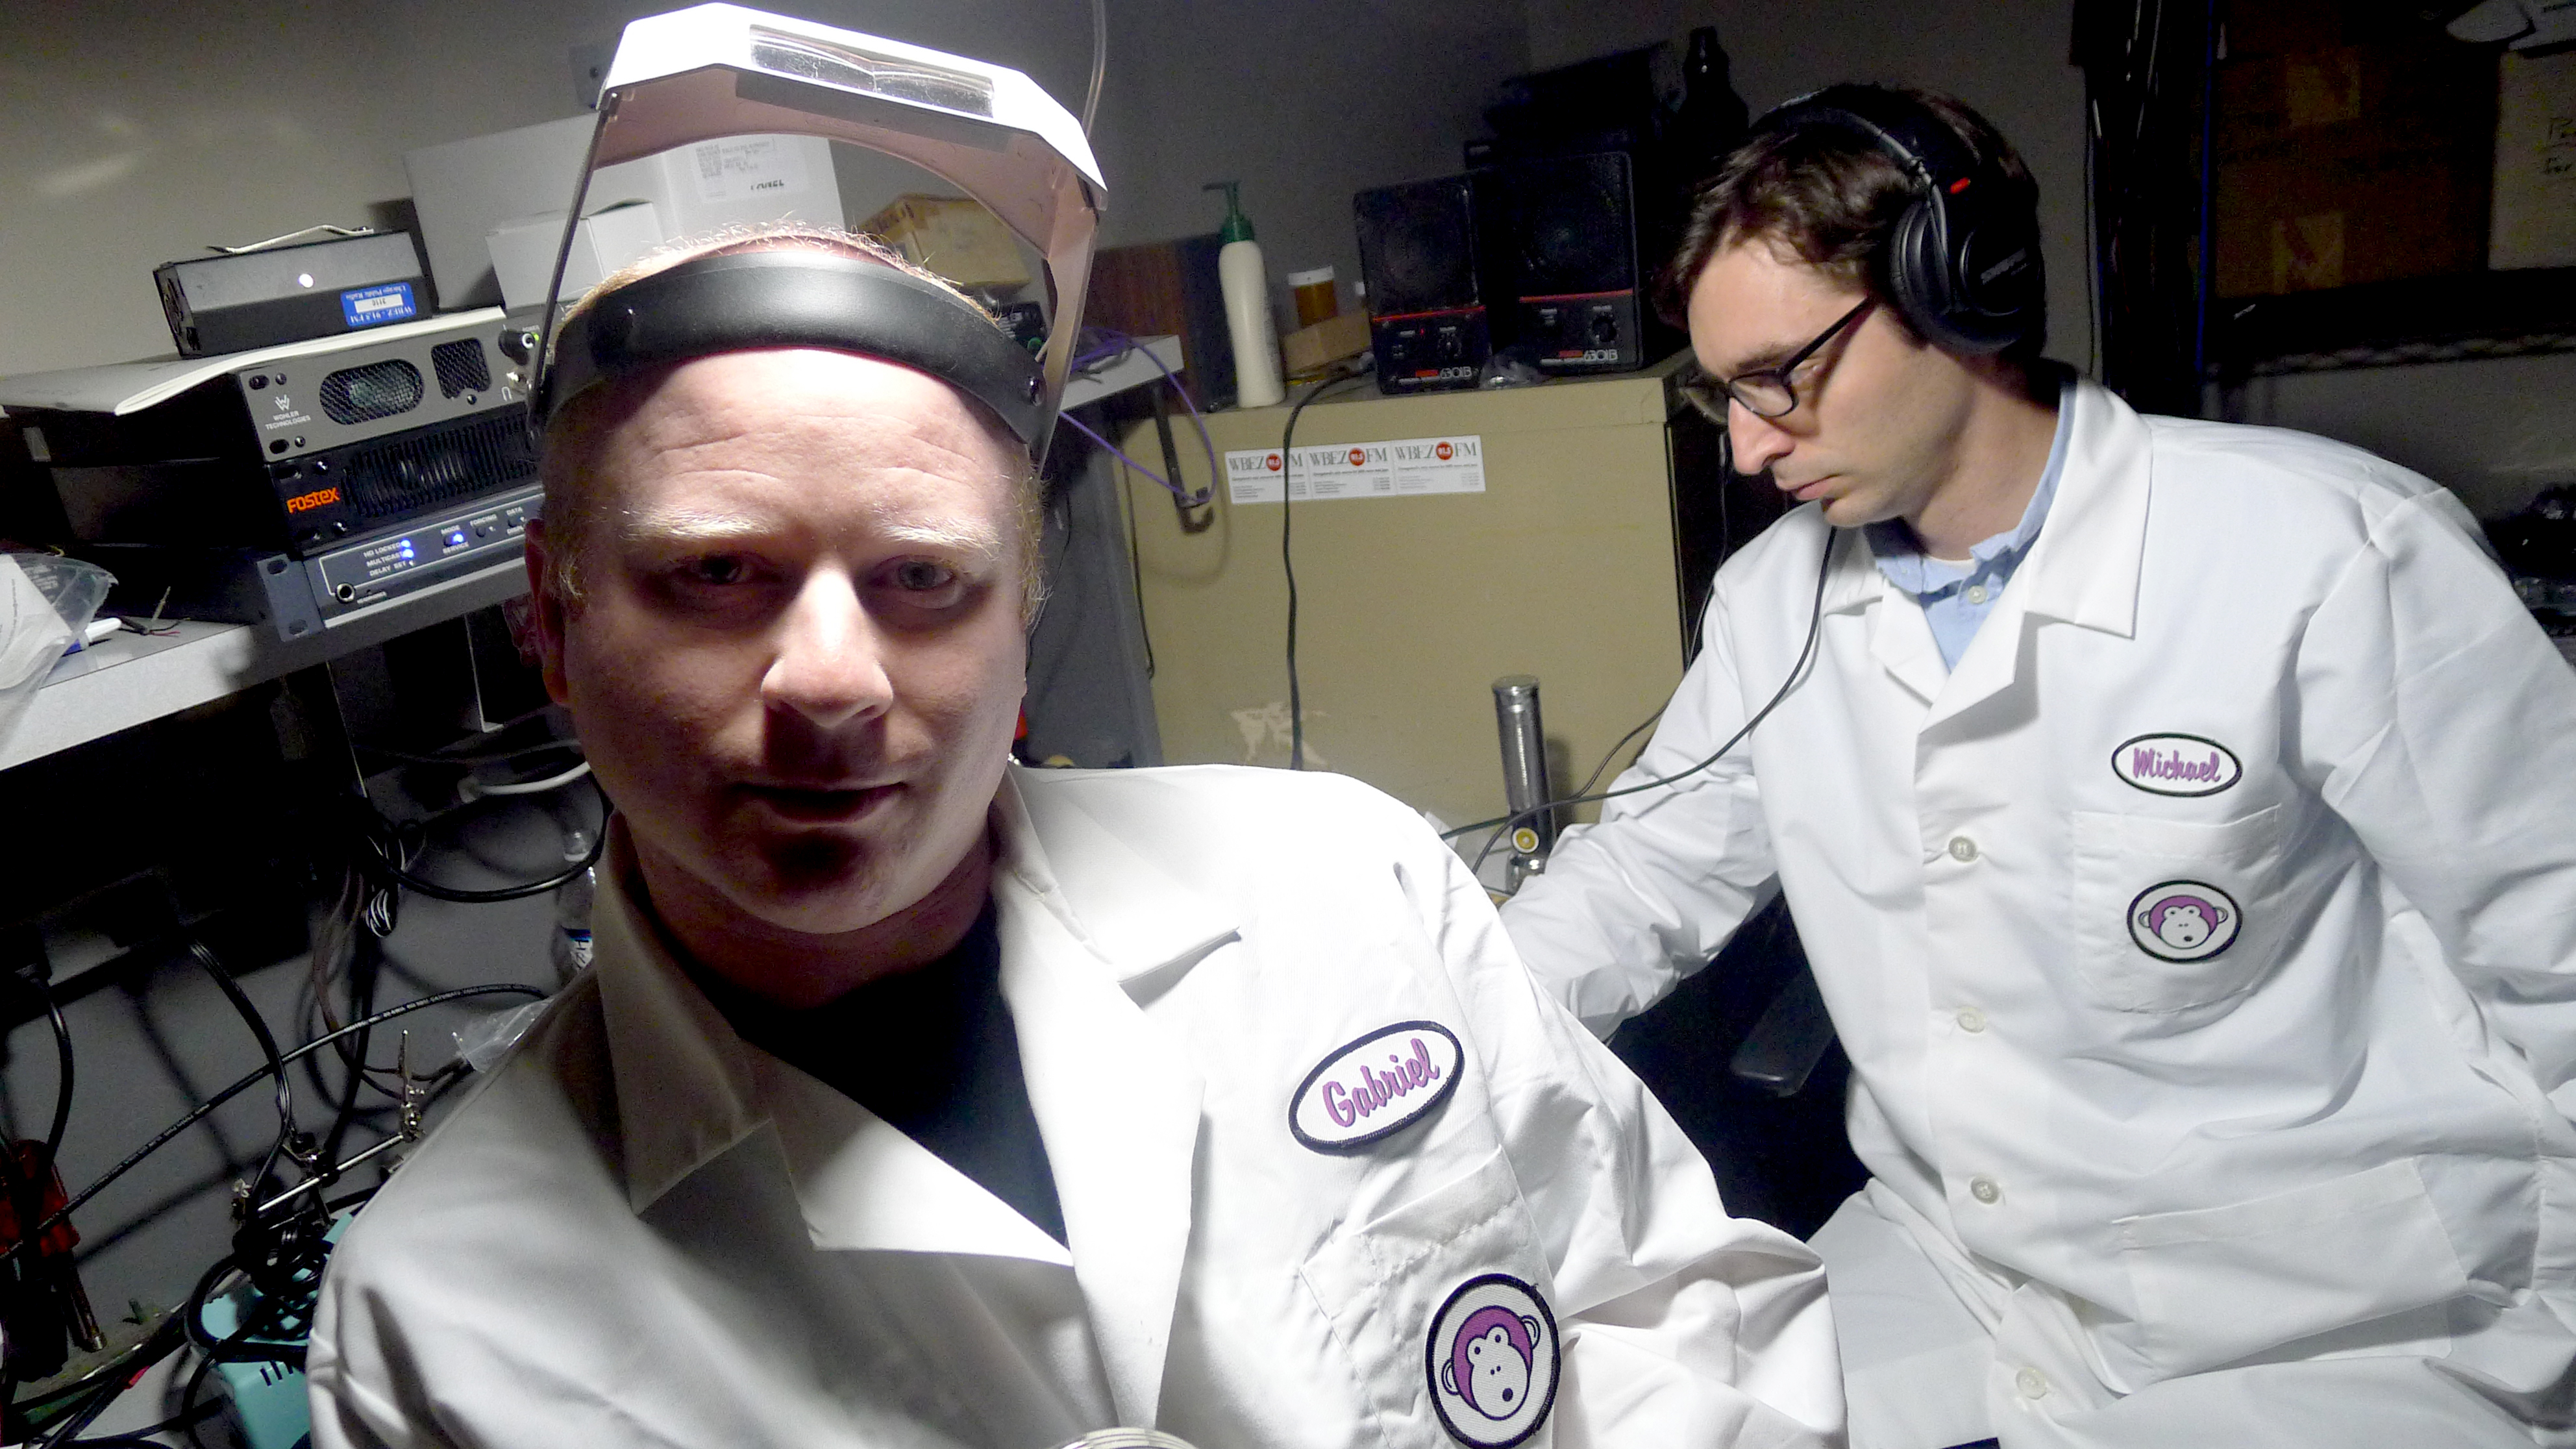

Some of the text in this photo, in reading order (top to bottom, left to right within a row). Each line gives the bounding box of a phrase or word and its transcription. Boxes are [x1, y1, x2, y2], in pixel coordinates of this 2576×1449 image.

[350, 314, 364, 323] FM
[265, 415, 312, 430] TECHNOLOGIES
[273, 410, 300, 421] WOHLER
[1309, 450, 1350, 465] WBEZ
[1365, 447, 1388, 462] FM
[1394, 444, 1436, 460] WBEZ
[1455, 441, 1477, 457] FM
[1228, 456, 1267, 471] WBEZ
[506, 506, 523, 517] DATA
[470, 514, 497, 526] FORCING
[441, 525, 460, 535] MODE
[375, 541, 401, 554] LOCKED
[443, 541, 469, 555] SERVICE
[366, 551, 404, 567] MULTICAST
[369, 560, 406, 576] DELAY SET
[2133, 747, 2221, 782] Michael
[1322, 1038, 1441, 1128] Gabriel
